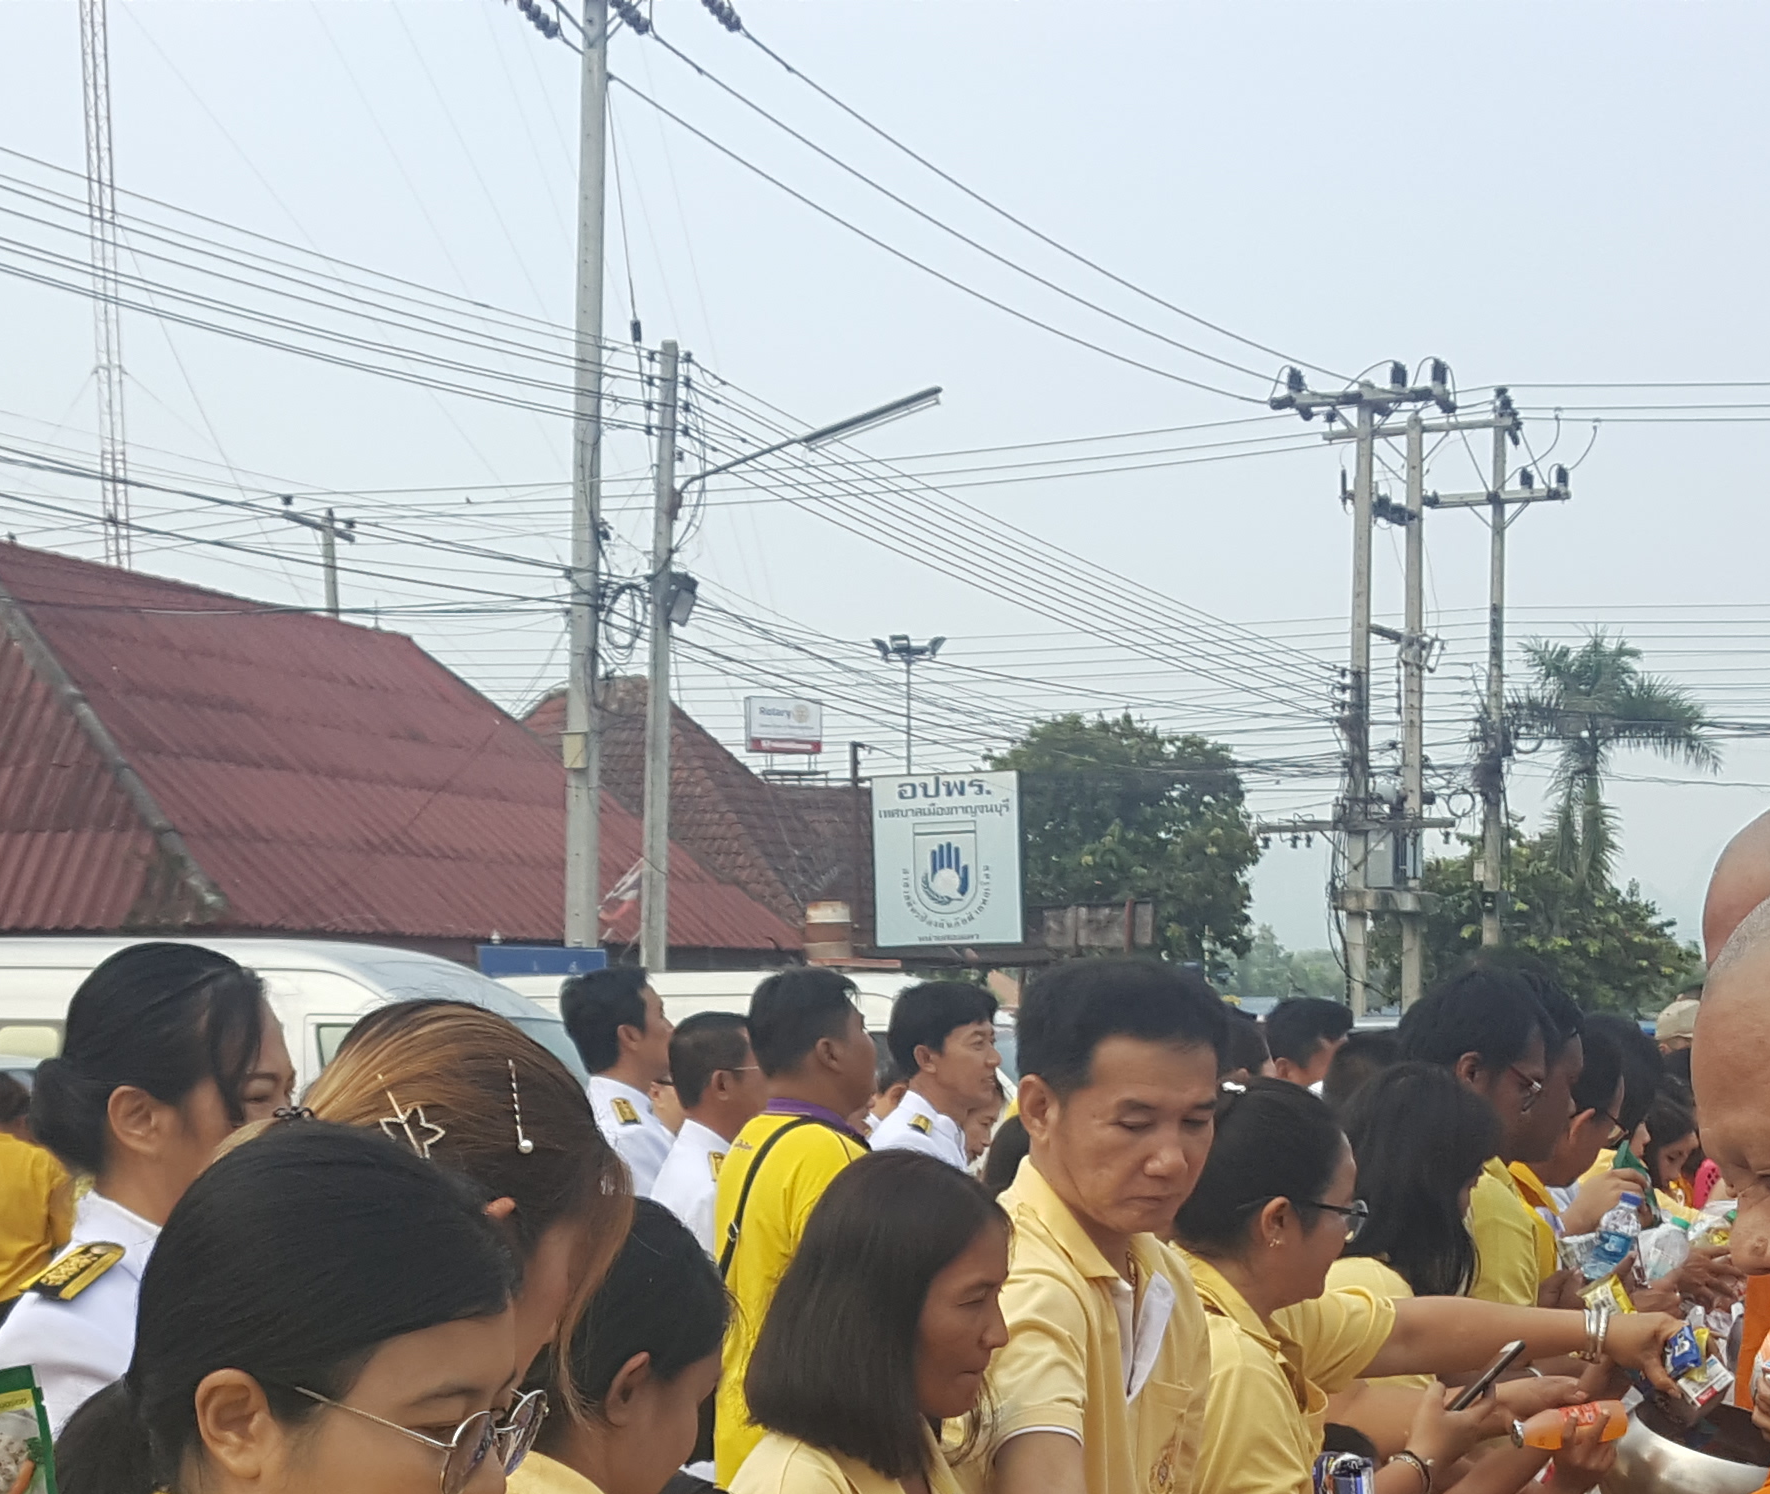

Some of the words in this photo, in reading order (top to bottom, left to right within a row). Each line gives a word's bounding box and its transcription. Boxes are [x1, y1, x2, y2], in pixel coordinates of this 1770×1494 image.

[897, 776, 992, 800] อปพร.
[879, 799, 1010, 819] เทศบาลเมืองกาญจนบุรี
